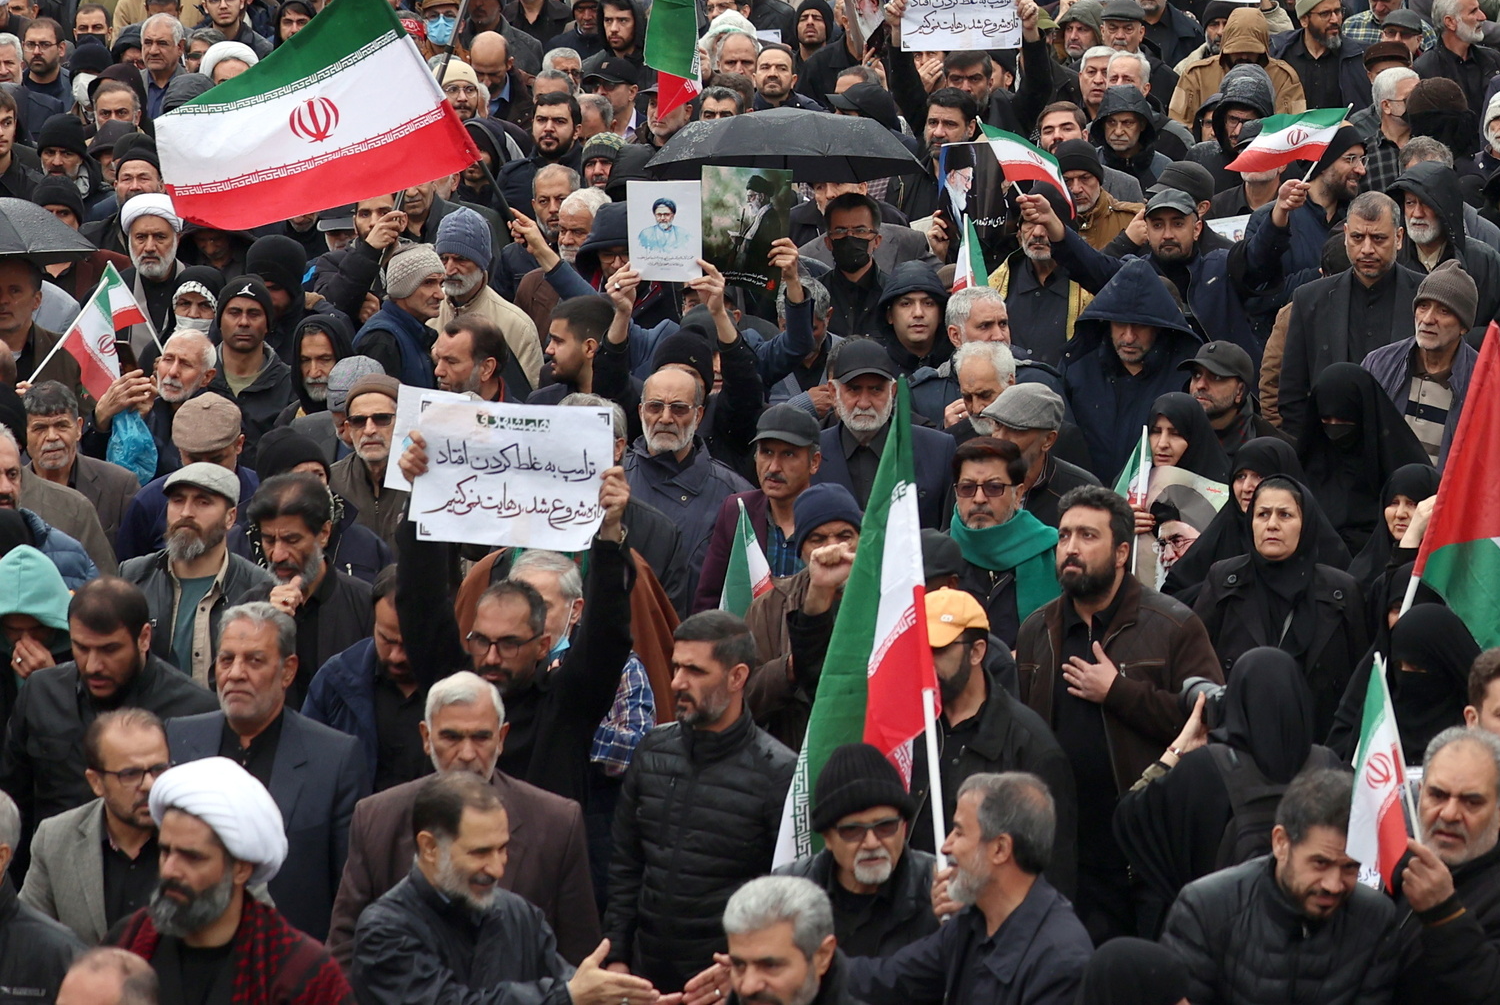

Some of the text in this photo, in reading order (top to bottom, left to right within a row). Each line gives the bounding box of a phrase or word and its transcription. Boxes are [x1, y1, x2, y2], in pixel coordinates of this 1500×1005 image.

[940, 12, 967, 34] رهایت
[981, 17, 1007, 37] شروع
[998, 11, 1019, 34] تازه
[436, 439, 597, 482] ترامپ به غلط کردن افتاد
[480, 481, 522, 519] رهایت
[548, 497, 586, 531] شروع
